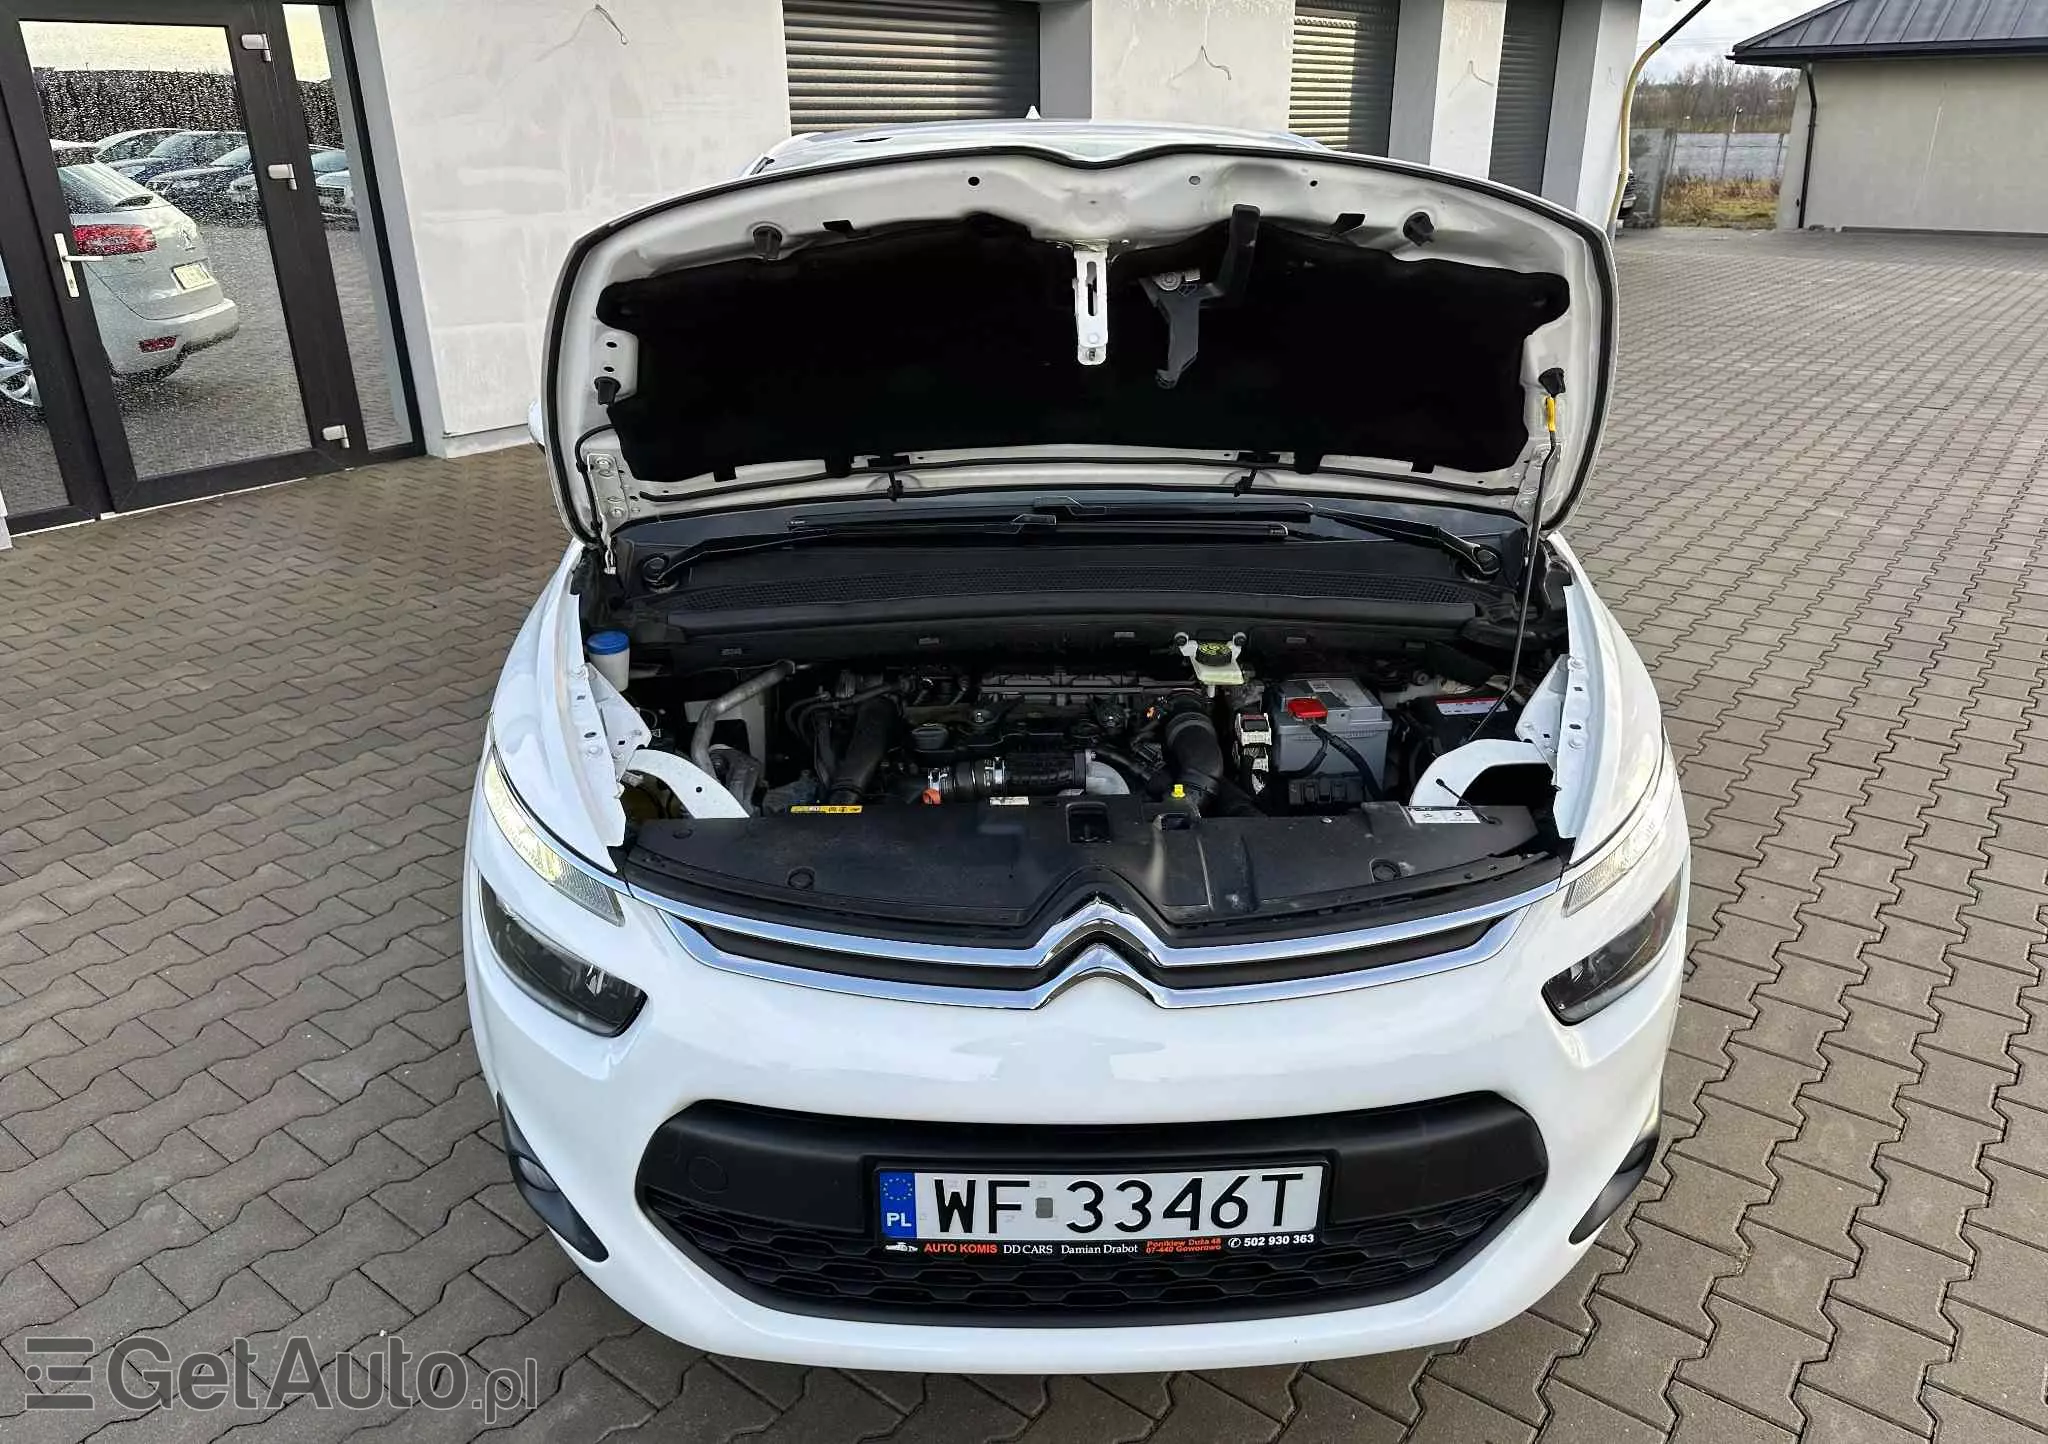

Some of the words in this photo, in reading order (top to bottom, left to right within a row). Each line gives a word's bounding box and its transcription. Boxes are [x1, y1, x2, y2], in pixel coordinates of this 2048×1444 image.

[933, 1178, 1031, 1234] WF
[1065, 1172, 1304, 1234] 3346T
[886, 1212, 912, 1228] PL
[1243, 1236, 1265, 1247] 502
[1268, 1235, 1290, 1246] 930
[1292, 1233, 1314, 1244] 363
[923, 1242, 957, 1254] AUTO
[959, 1242, 998, 1255] KOMIS
[1003, 1244, 1021, 1254] DD
[1022, 1244, 1053, 1254] CARS
[1061, 1244, 1101, 1255] Damian
[1103, 1243, 1138, 1255] Drabot
